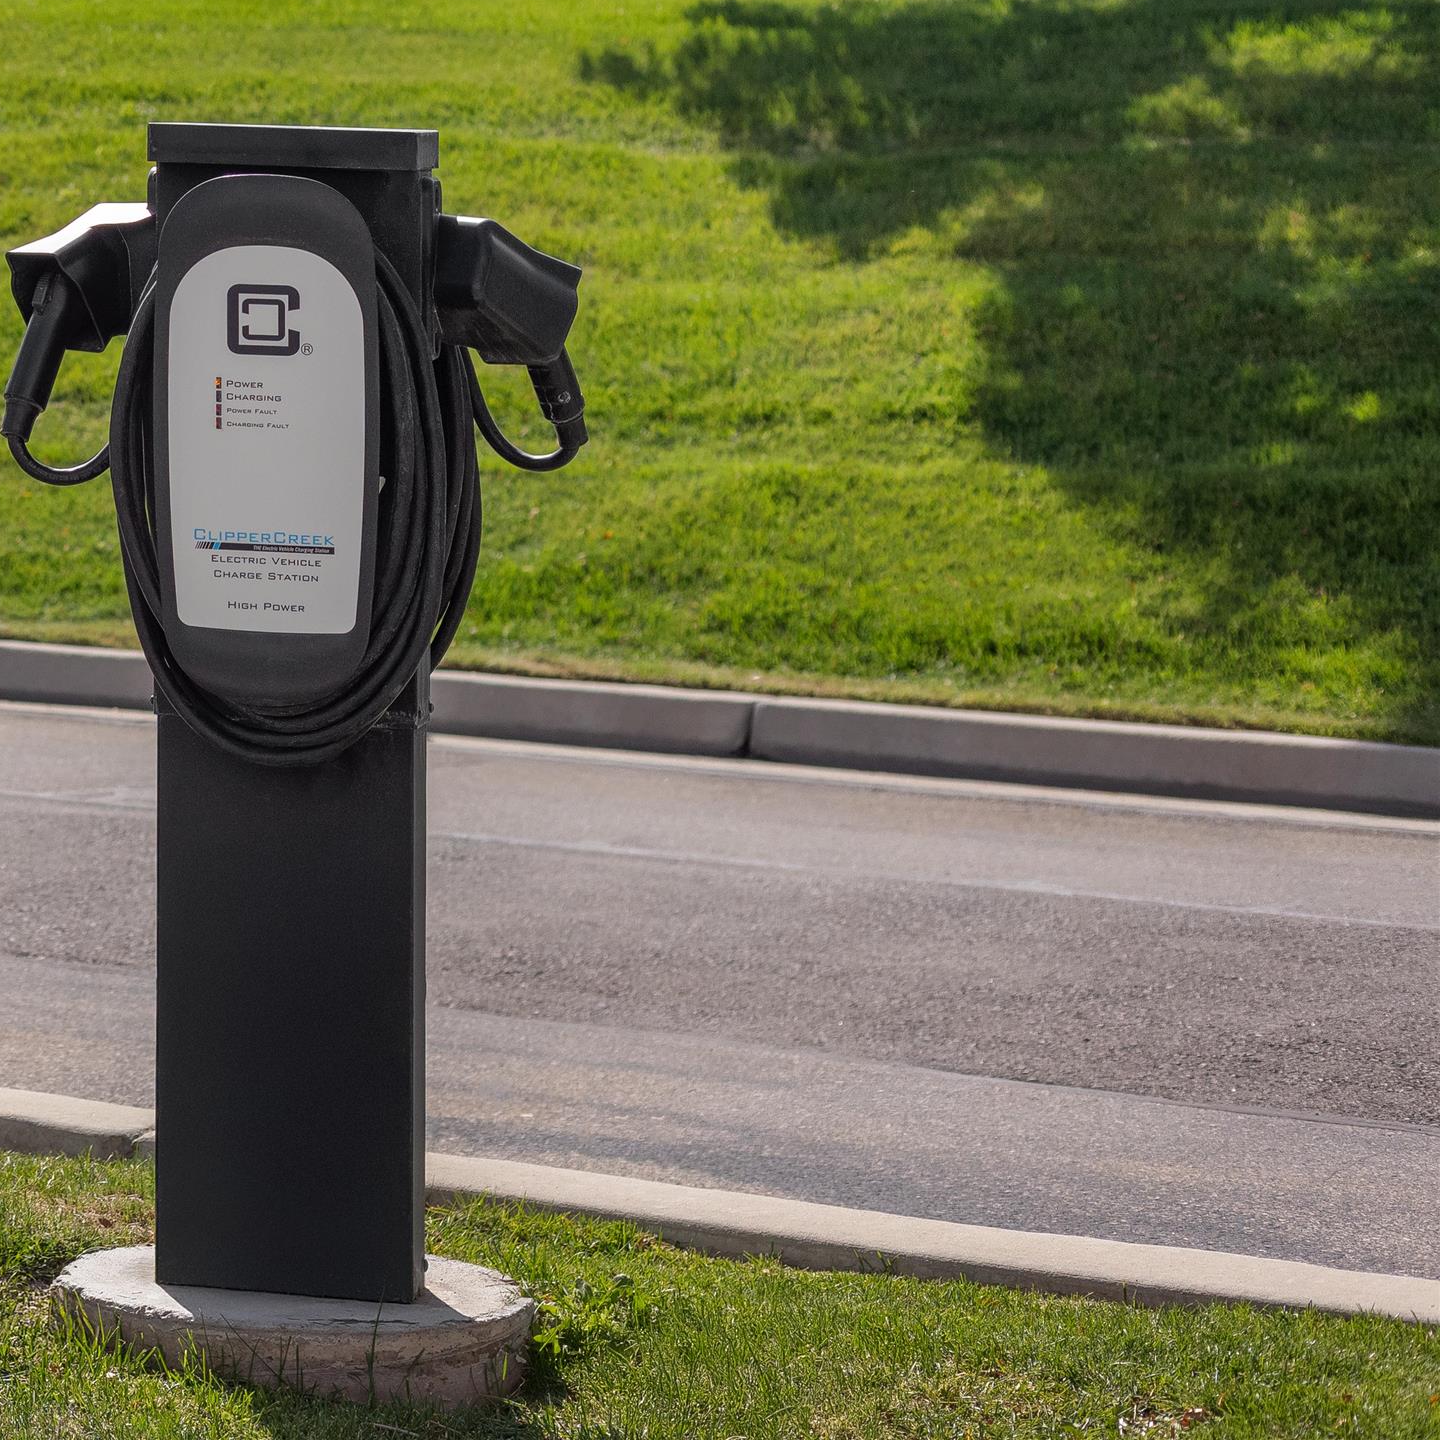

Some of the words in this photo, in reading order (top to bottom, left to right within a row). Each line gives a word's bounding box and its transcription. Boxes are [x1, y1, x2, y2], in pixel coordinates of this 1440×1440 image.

[226, 380, 264, 389] POWER
[226, 392, 282, 402] CHARGING
[211, 554, 267, 565] ELECTRIC
[271, 556, 322, 568] VEHICLE
[213, 569, 263, 580] CHARGE
[267, 572, 320, 583] STATION
[227, 601, 258, 611] HIGH
[263, 602, 305, 612] POWER
